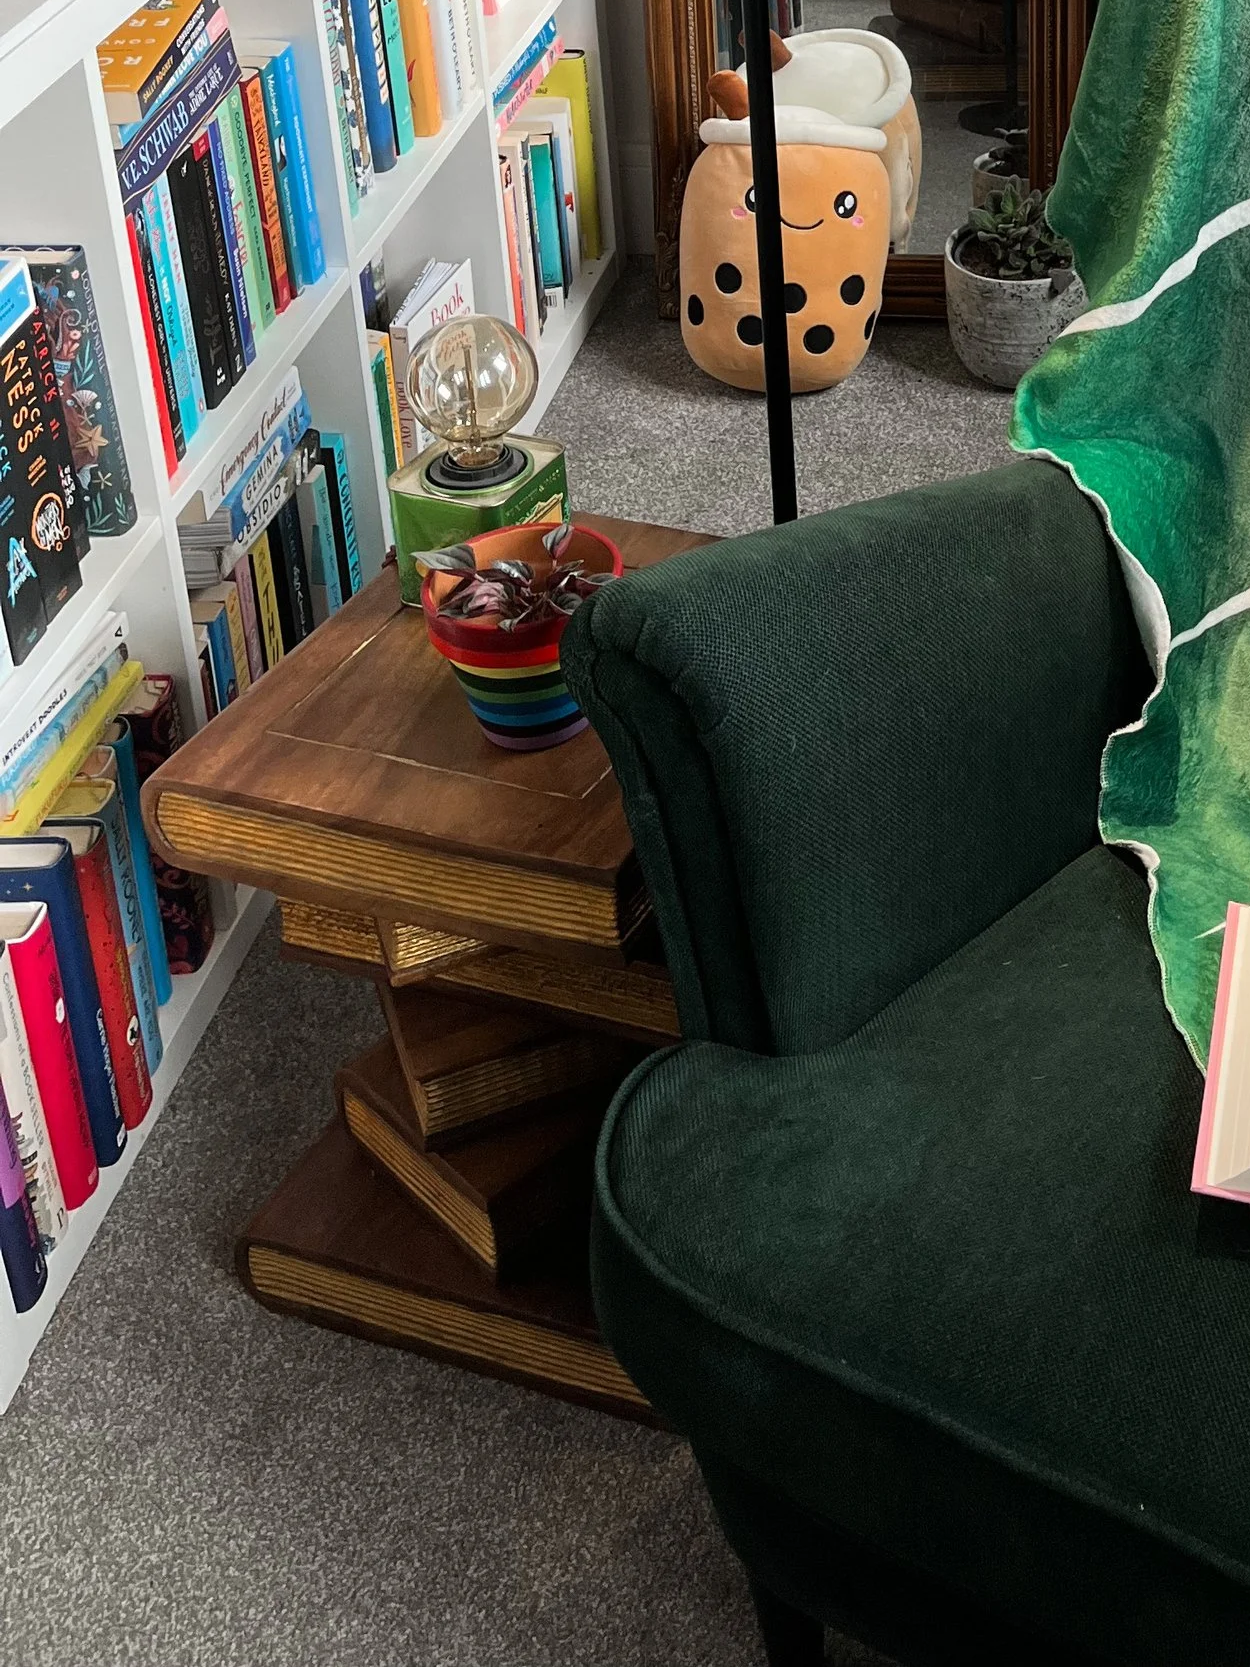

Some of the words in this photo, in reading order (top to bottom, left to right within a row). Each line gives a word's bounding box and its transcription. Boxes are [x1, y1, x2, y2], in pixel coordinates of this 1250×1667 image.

[447, 8, 457, 41] BETH
[450, 41, 463, 93] O'LEARY
[137, 99, 190, 175] SCHWAB
[242, 171, 257, 219] PERFECT
[159, 275, 173, 303] NOT
[171, 245, 183, 284] HAN
[79, 268, 96, 318] LOUISE
[236, 276, 248, 318] Nielsen
[430, 282, 465, 324] Book
[147, 273, 161, 322] LONELIEST
[163, 366, 177, 411] UNIVERSE
[1, 346, 35, 455] NESS
[15, 339, 44, 437] PATRICK
[245, 444, 280, 501] GEMINA
[236, 483, 282, 544] OBSIDIO
[1, 721, 38, 767] INTROVERT
[37, 686, 69, 725] DOODLES
[0, 971, 24, 1048] Confessions
[20, 1065, 46, 1149] BOOKSELLER
